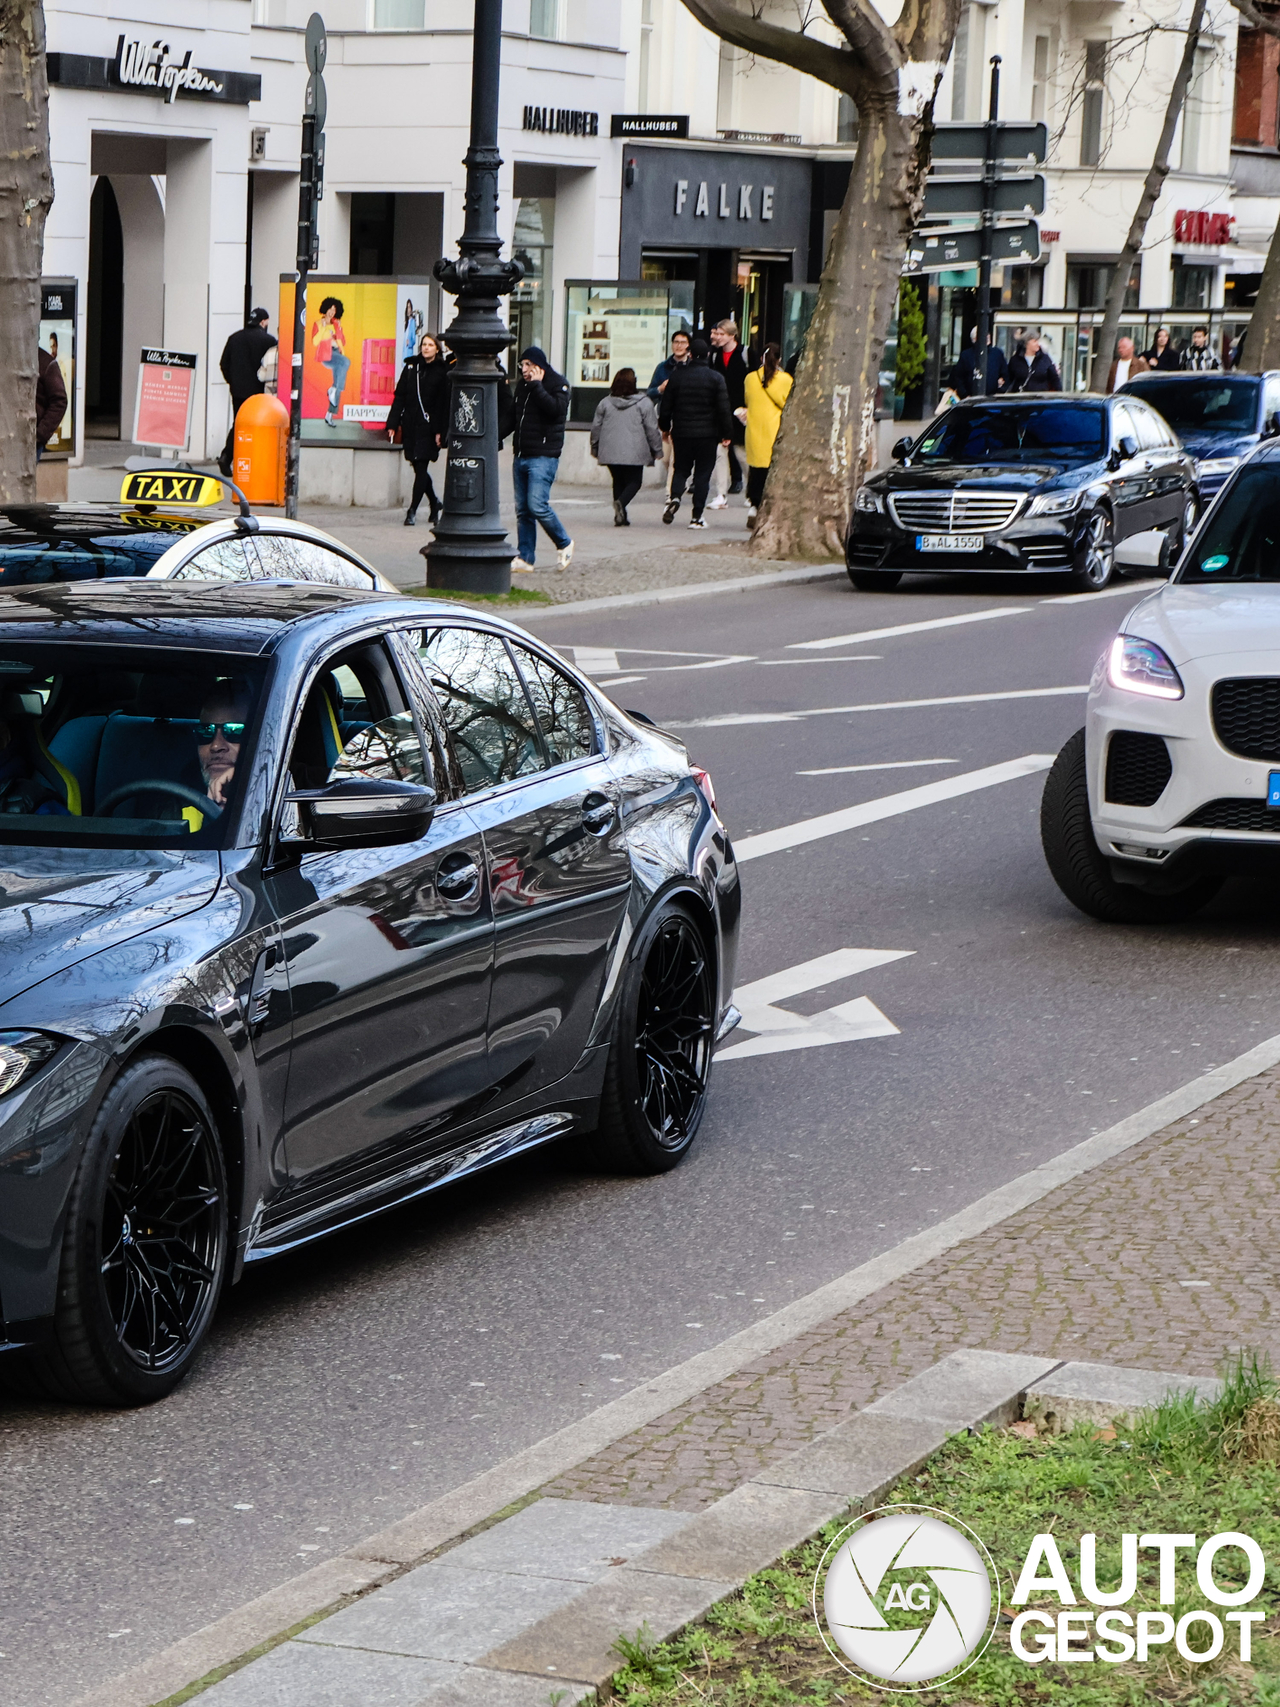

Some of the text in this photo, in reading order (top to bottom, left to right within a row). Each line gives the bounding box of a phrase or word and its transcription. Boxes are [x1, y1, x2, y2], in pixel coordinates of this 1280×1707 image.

[118, 34, 223, 104] Ulla Popken
[522, 105, 599, 136] HALLHUBER
[622, 121, 678, 131] HALLHUBER
[675, 179, 775, 219] FALKE
[146, 350, 190, 366] Ulla Popken
[346, 408, 377, 417] HAPPY
[136, 477, 197, 500] TAXI
[923, 537, 981, 548] B AL 1550
